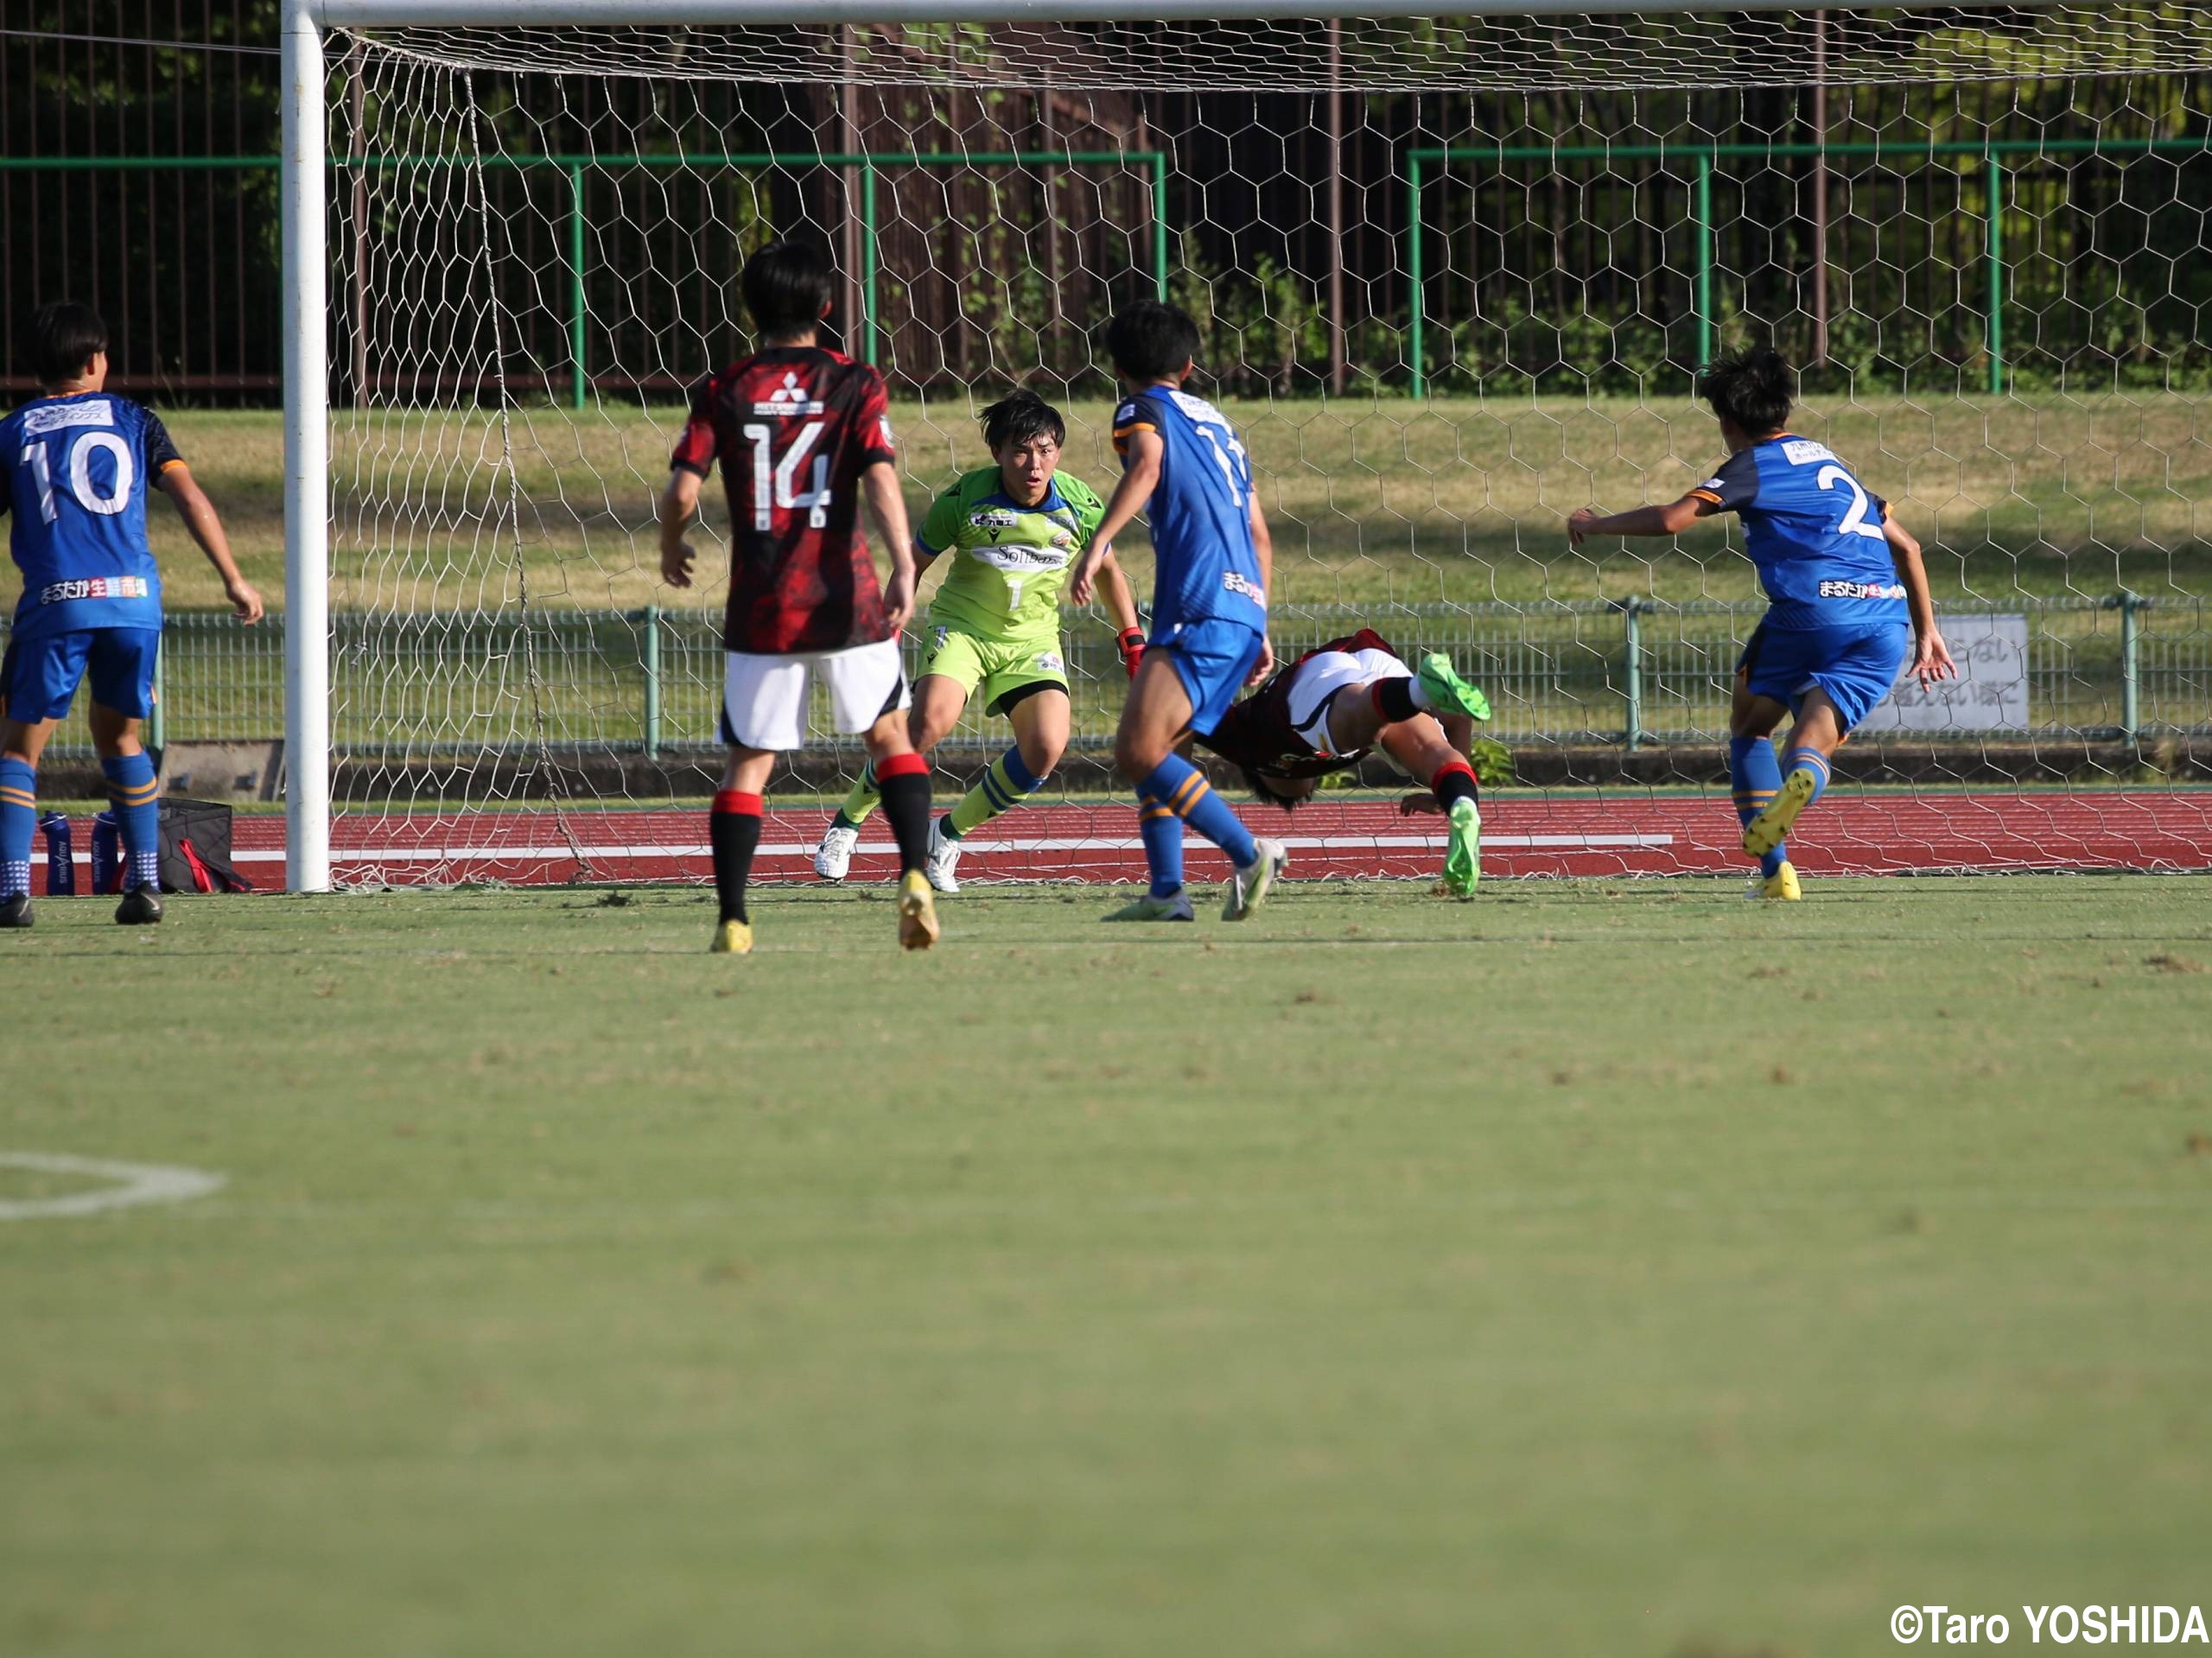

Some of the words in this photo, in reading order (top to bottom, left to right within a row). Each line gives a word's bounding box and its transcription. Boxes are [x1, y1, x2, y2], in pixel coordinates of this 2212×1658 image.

[20, 432, 133, 524] 10
[743, 422, 832, 530] 14
[1816, 463, 1885, 542] 2
[1007, 580, 1022, 612] 1
[1820, 580, 1908, 599] まるたか生
[54, 841, 70, 884] AQUARIUS
